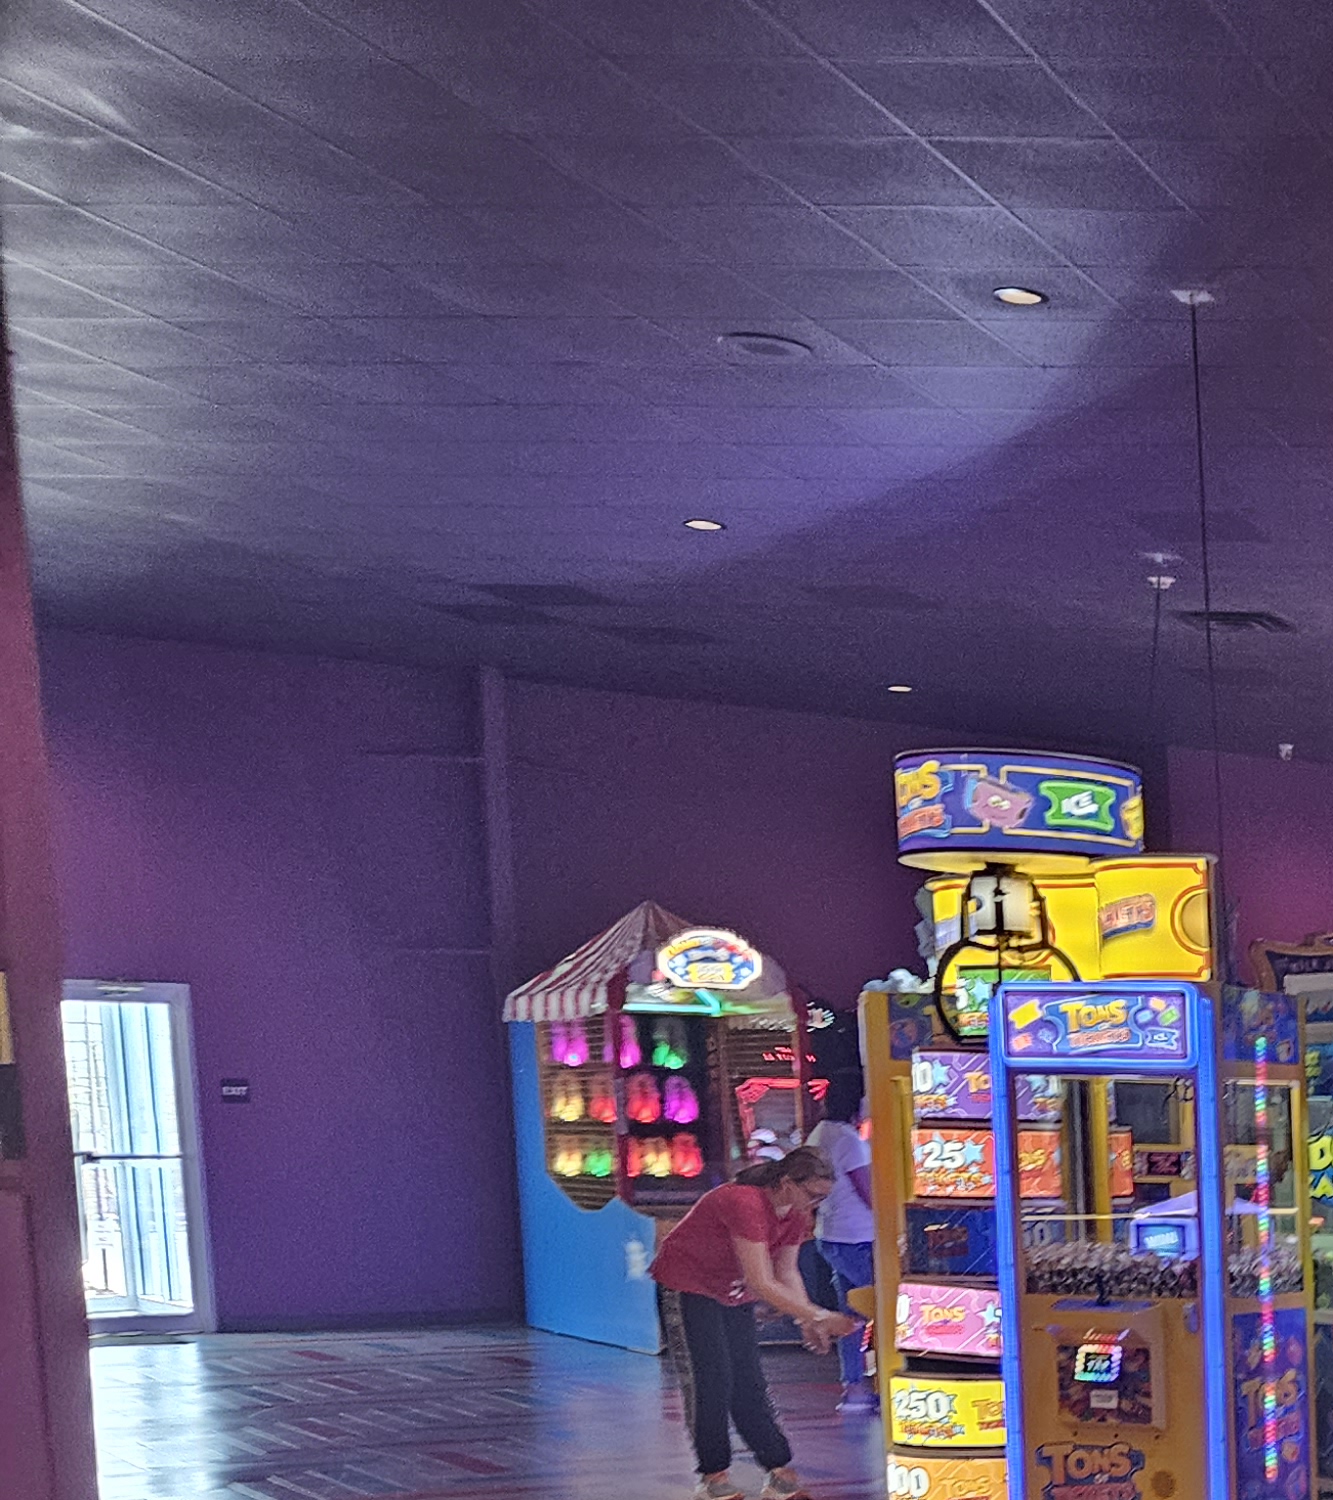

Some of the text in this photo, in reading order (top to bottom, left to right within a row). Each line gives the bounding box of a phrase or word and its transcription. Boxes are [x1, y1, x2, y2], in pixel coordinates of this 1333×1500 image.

[1059, 999, 1129, 1033] TONS
[222, 1086, 248, 1096] EXIT
[920, 1140, 966, 1170] 25
[918, 1303, 967, 1324] TONS
[1041, 1443, 1133, 1486] TONS
